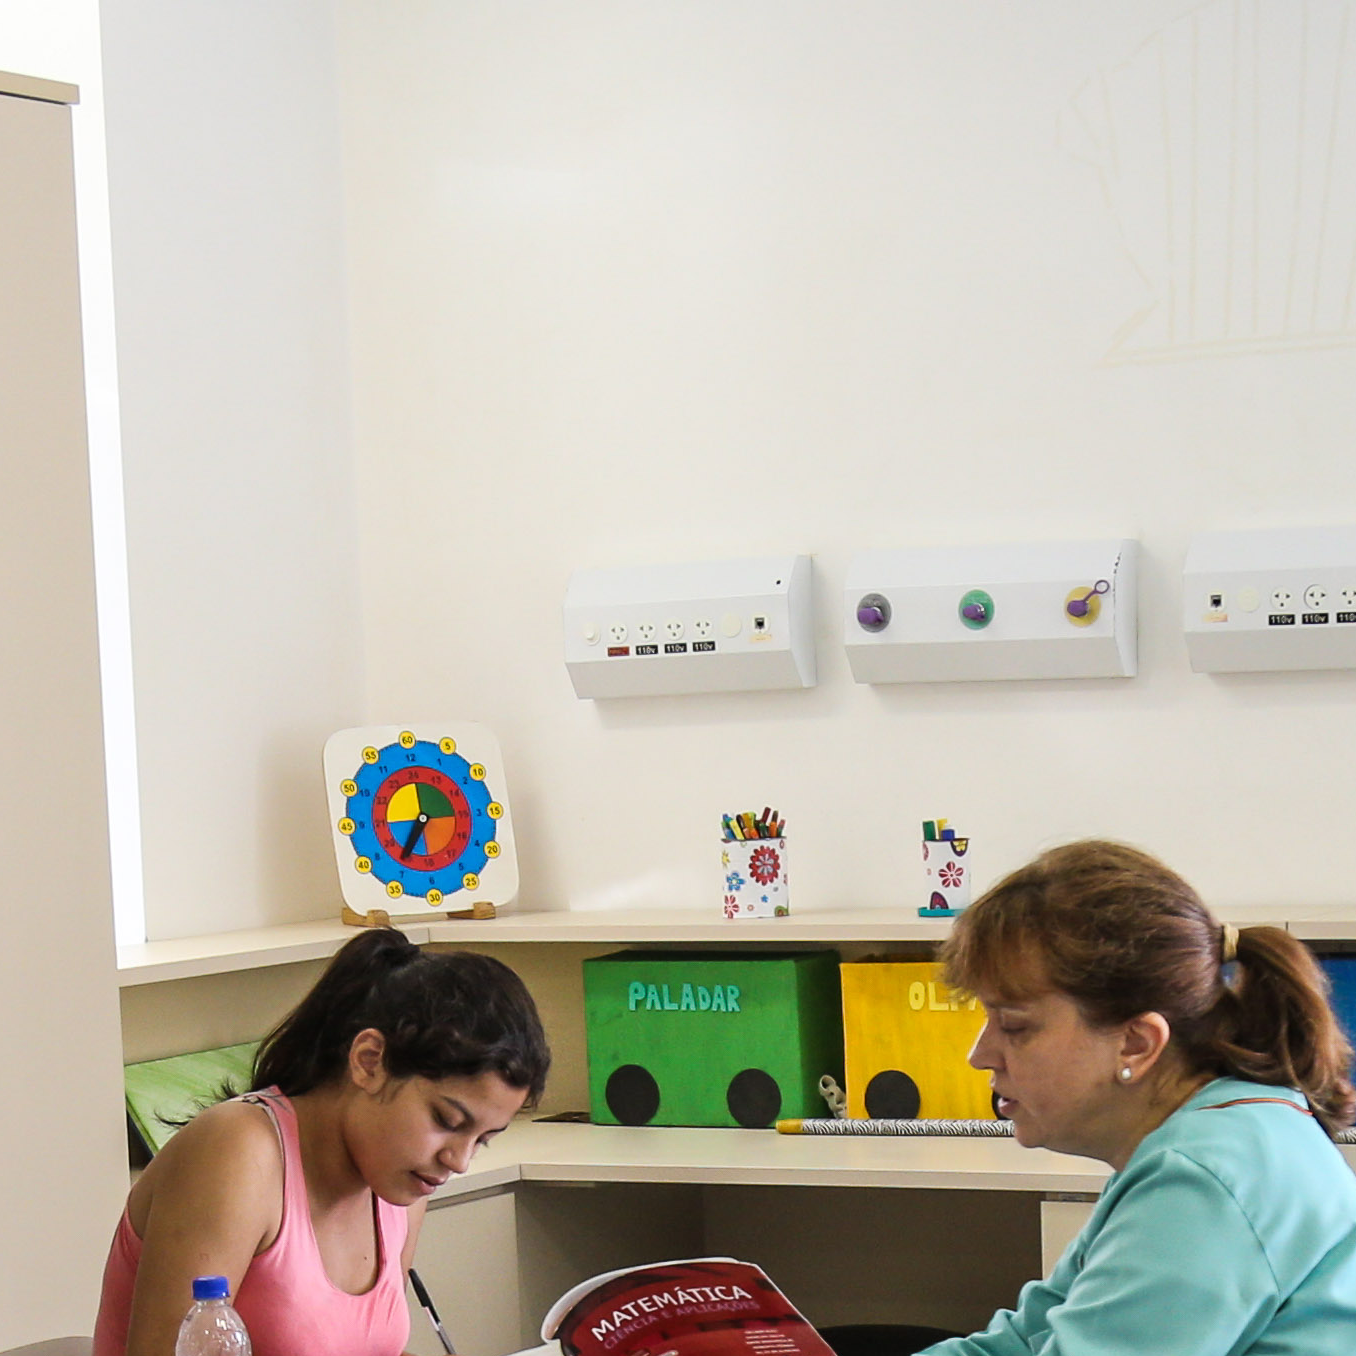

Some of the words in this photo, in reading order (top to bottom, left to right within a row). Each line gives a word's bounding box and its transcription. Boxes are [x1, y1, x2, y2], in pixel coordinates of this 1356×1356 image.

[402, 736, 413, 744] 60
[406, 754, 416, 762] 12
[473, 768, 483, 776] 10
[343, 784, 355, 792] 50
[487, 845, 498, 853] 20
[358, 861, 370, 869] 40
[466, 878, 476, 886] 25
[389, 885, 401, 893] 35
[429, 893, 440, 901] 30
[628, 981, 741, 1012] PALADAR
[591, 1285, 753, 1342] MATEMÁTICA
